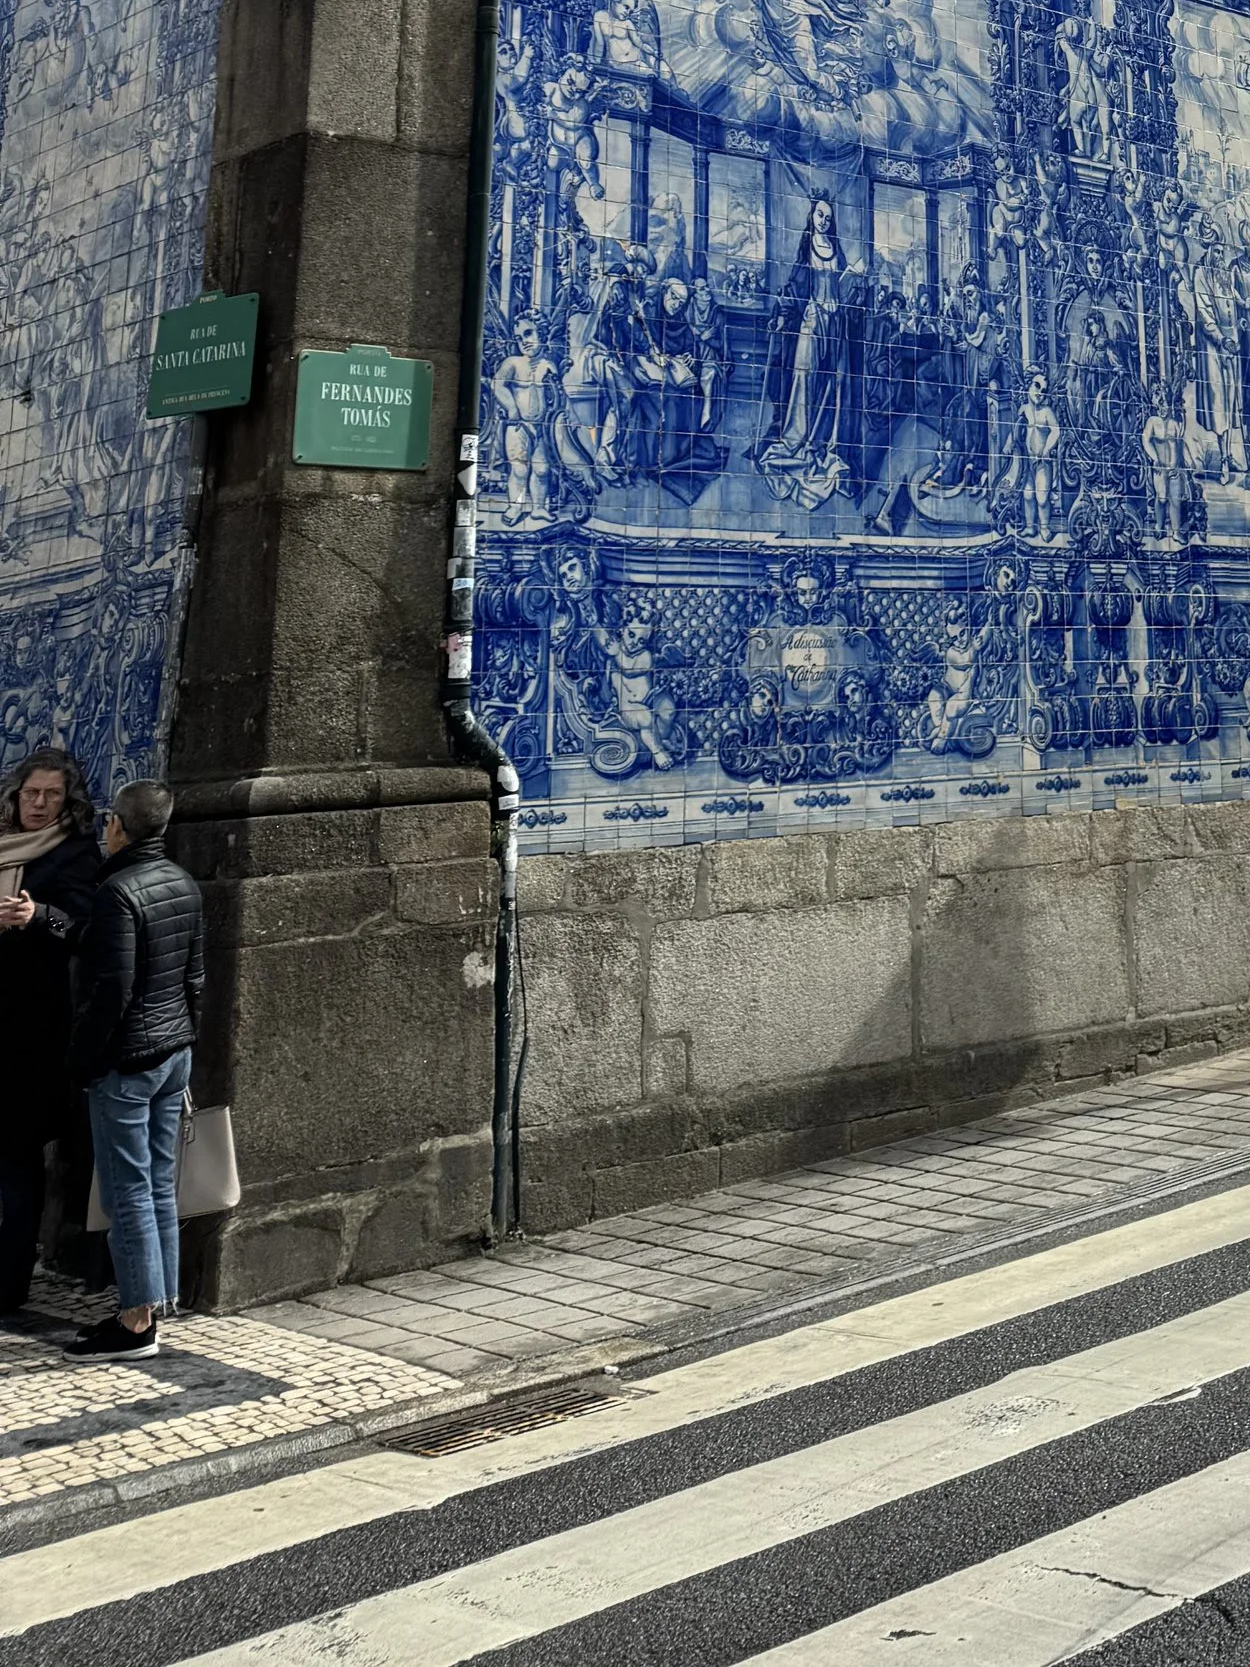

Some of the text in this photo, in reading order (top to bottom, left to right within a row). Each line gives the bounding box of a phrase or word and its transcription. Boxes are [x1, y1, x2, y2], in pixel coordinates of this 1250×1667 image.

[190, 324, 218, 340] RUA DE
[156, 341, 246, 371] SANTA CATARINA
[349, 363, 388, 378] RUA DE
[321, 382, 412, 406] FERNANDES
[341, 405, 391, 428] TOMÁS
[803, 653, 812, 662] de
